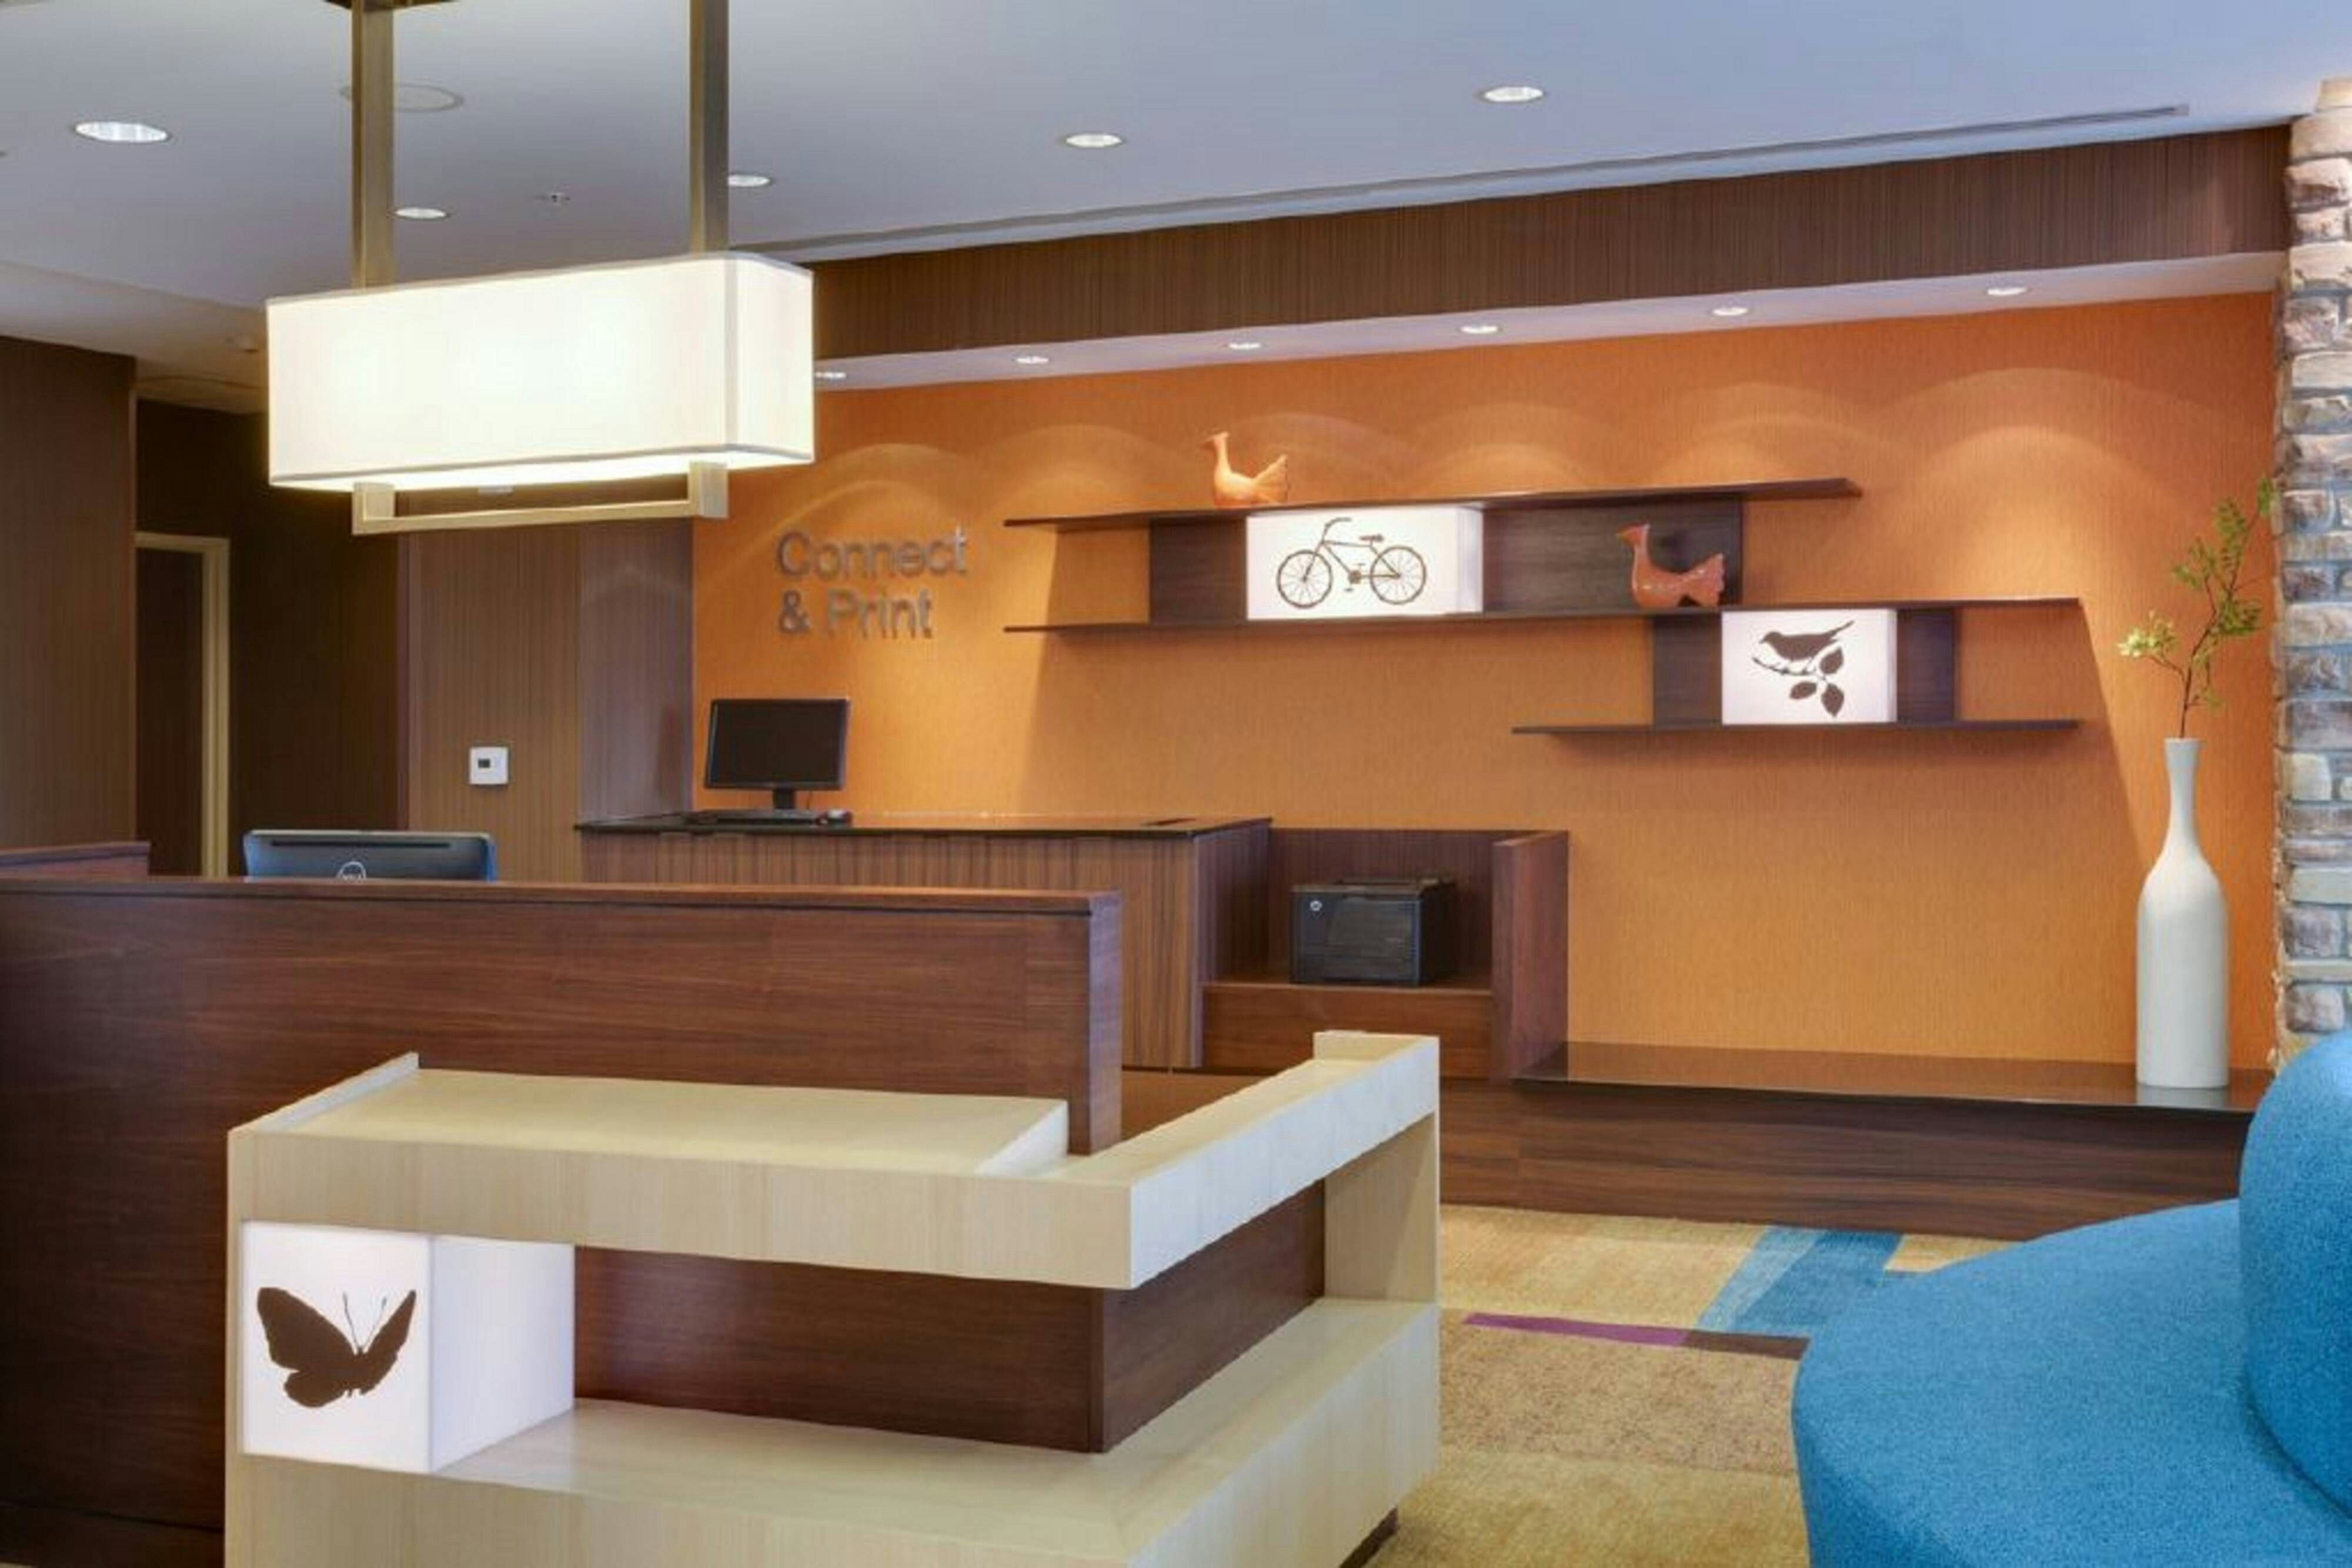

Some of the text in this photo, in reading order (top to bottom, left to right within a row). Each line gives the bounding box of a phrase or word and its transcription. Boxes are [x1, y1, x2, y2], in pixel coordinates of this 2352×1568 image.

[777, 526, 968, 579] Connect
[779, 588, 933, 639] & Print
